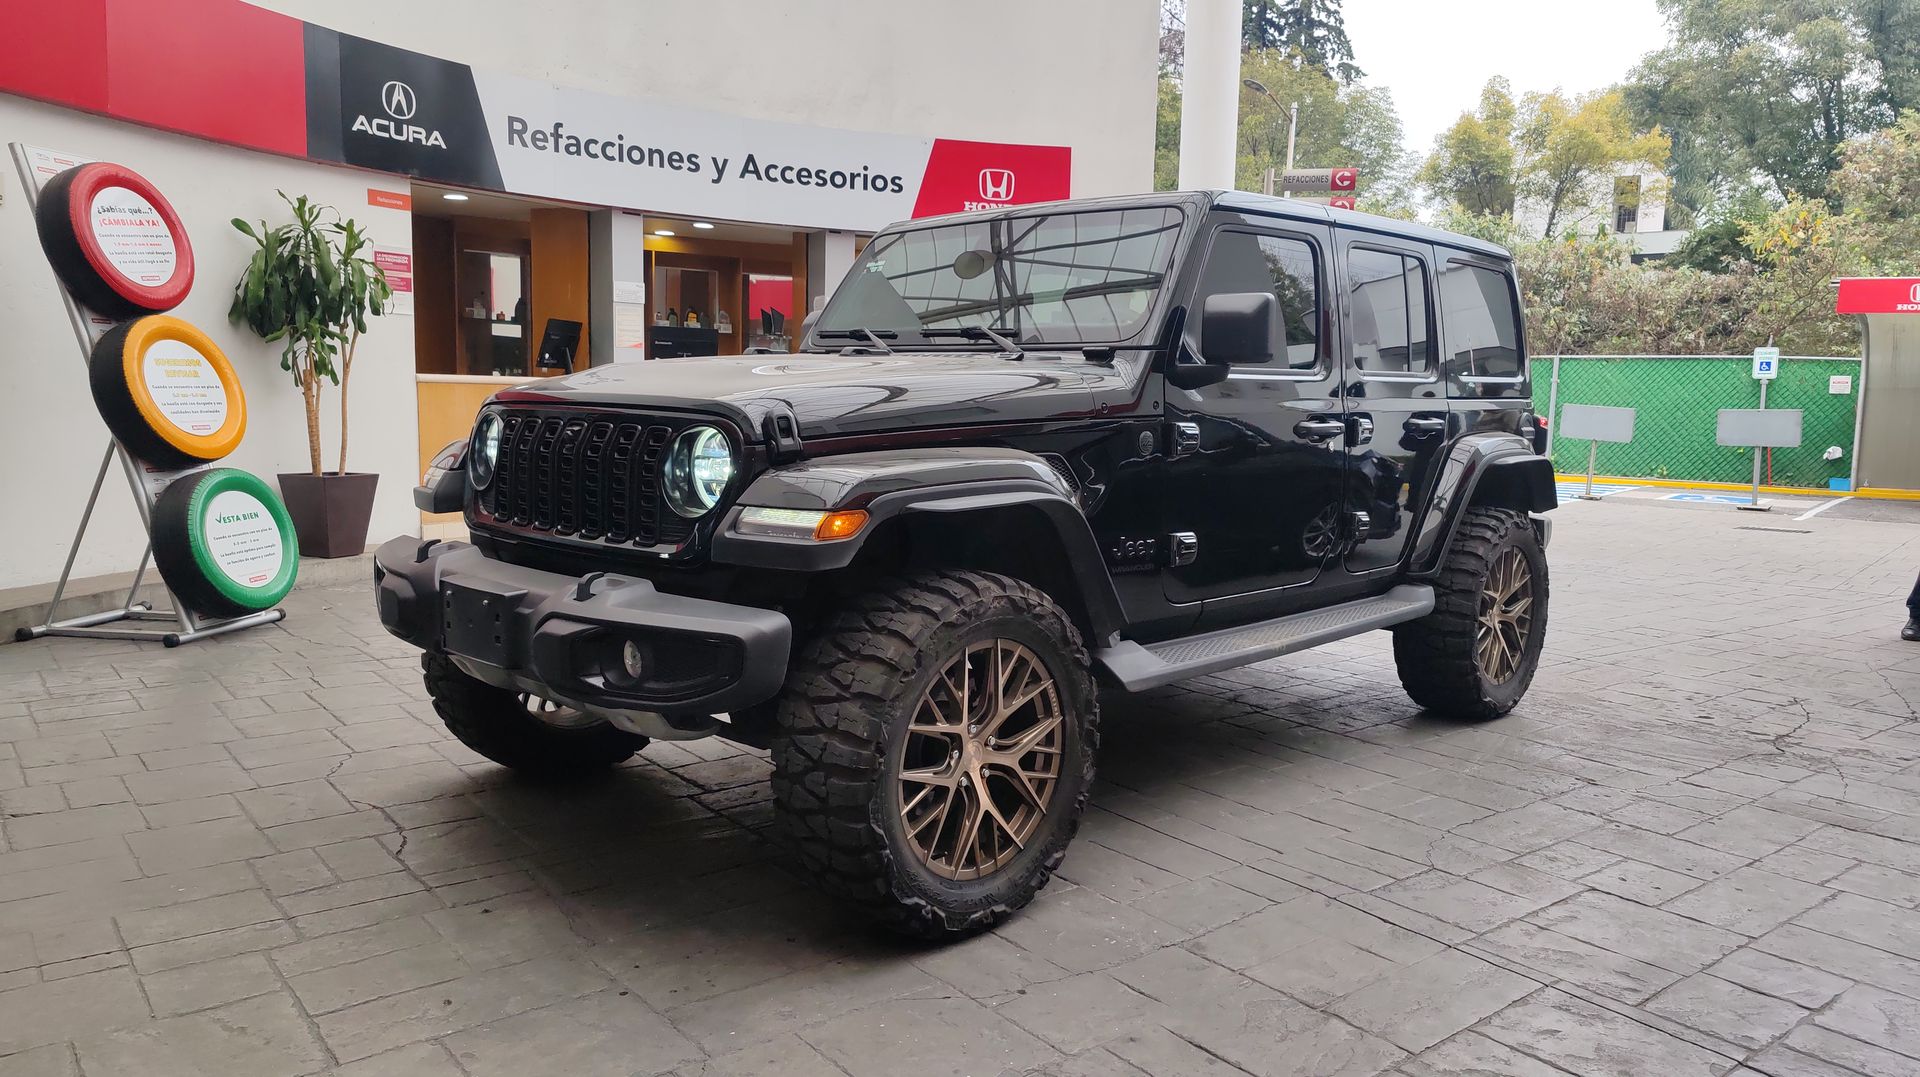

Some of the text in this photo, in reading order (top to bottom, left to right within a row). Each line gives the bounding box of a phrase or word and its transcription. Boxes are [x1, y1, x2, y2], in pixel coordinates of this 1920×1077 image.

[352, 115, 447, 149] ACURA
[507, 115, 903, 194] Refacciones y Accesorios
[1283, 175, 1329, 184] REFACCIONES
[241, 511, 259, 521] BIEN
[1112, 536, 1155, 558] Jeep
